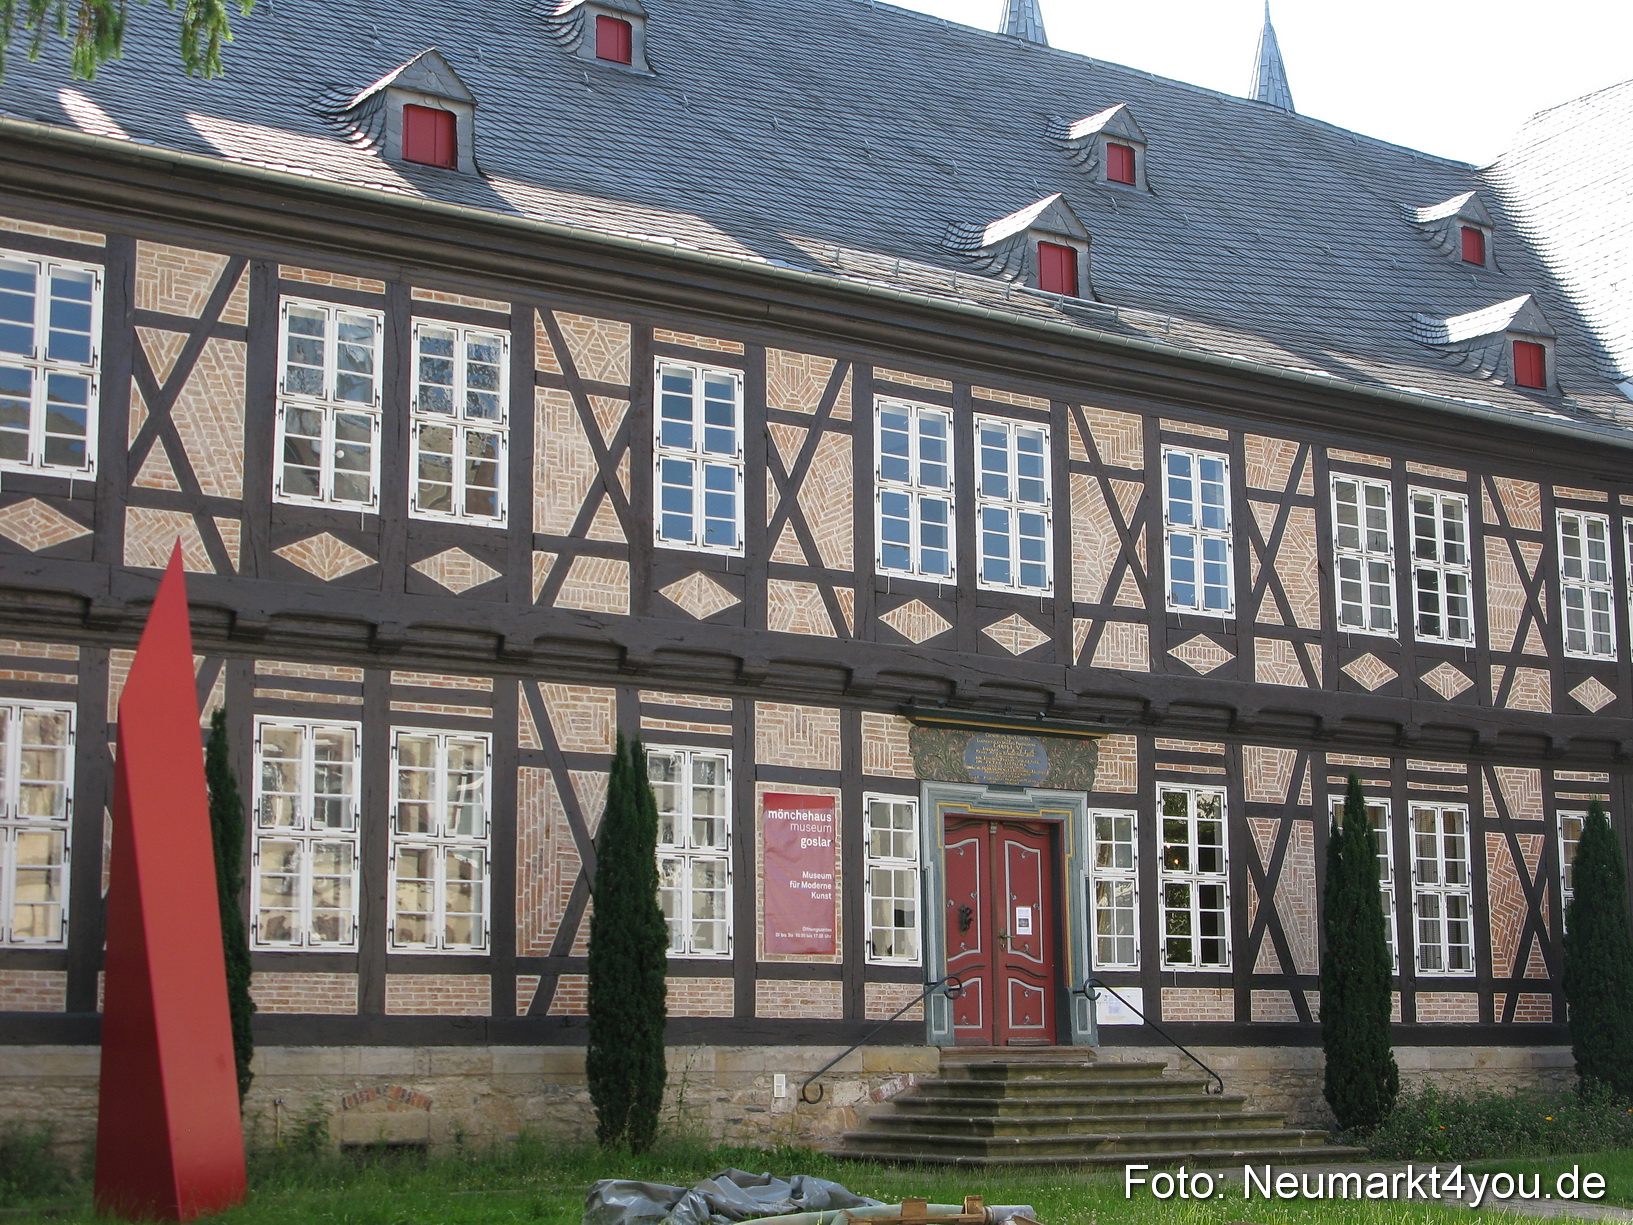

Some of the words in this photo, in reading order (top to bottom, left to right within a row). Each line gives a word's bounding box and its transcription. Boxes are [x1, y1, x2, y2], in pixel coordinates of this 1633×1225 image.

[768, 808, 832, 822] mönchehaus
[790, 823, 832, 833] museum
[800, 836, 832, 849] goslar
[802, 871, 832, 880] Museum
[789, 880, 800, 889] für
[801, 881, 832, 890] Moderne
[811, 891, 832, 900] Kunst
